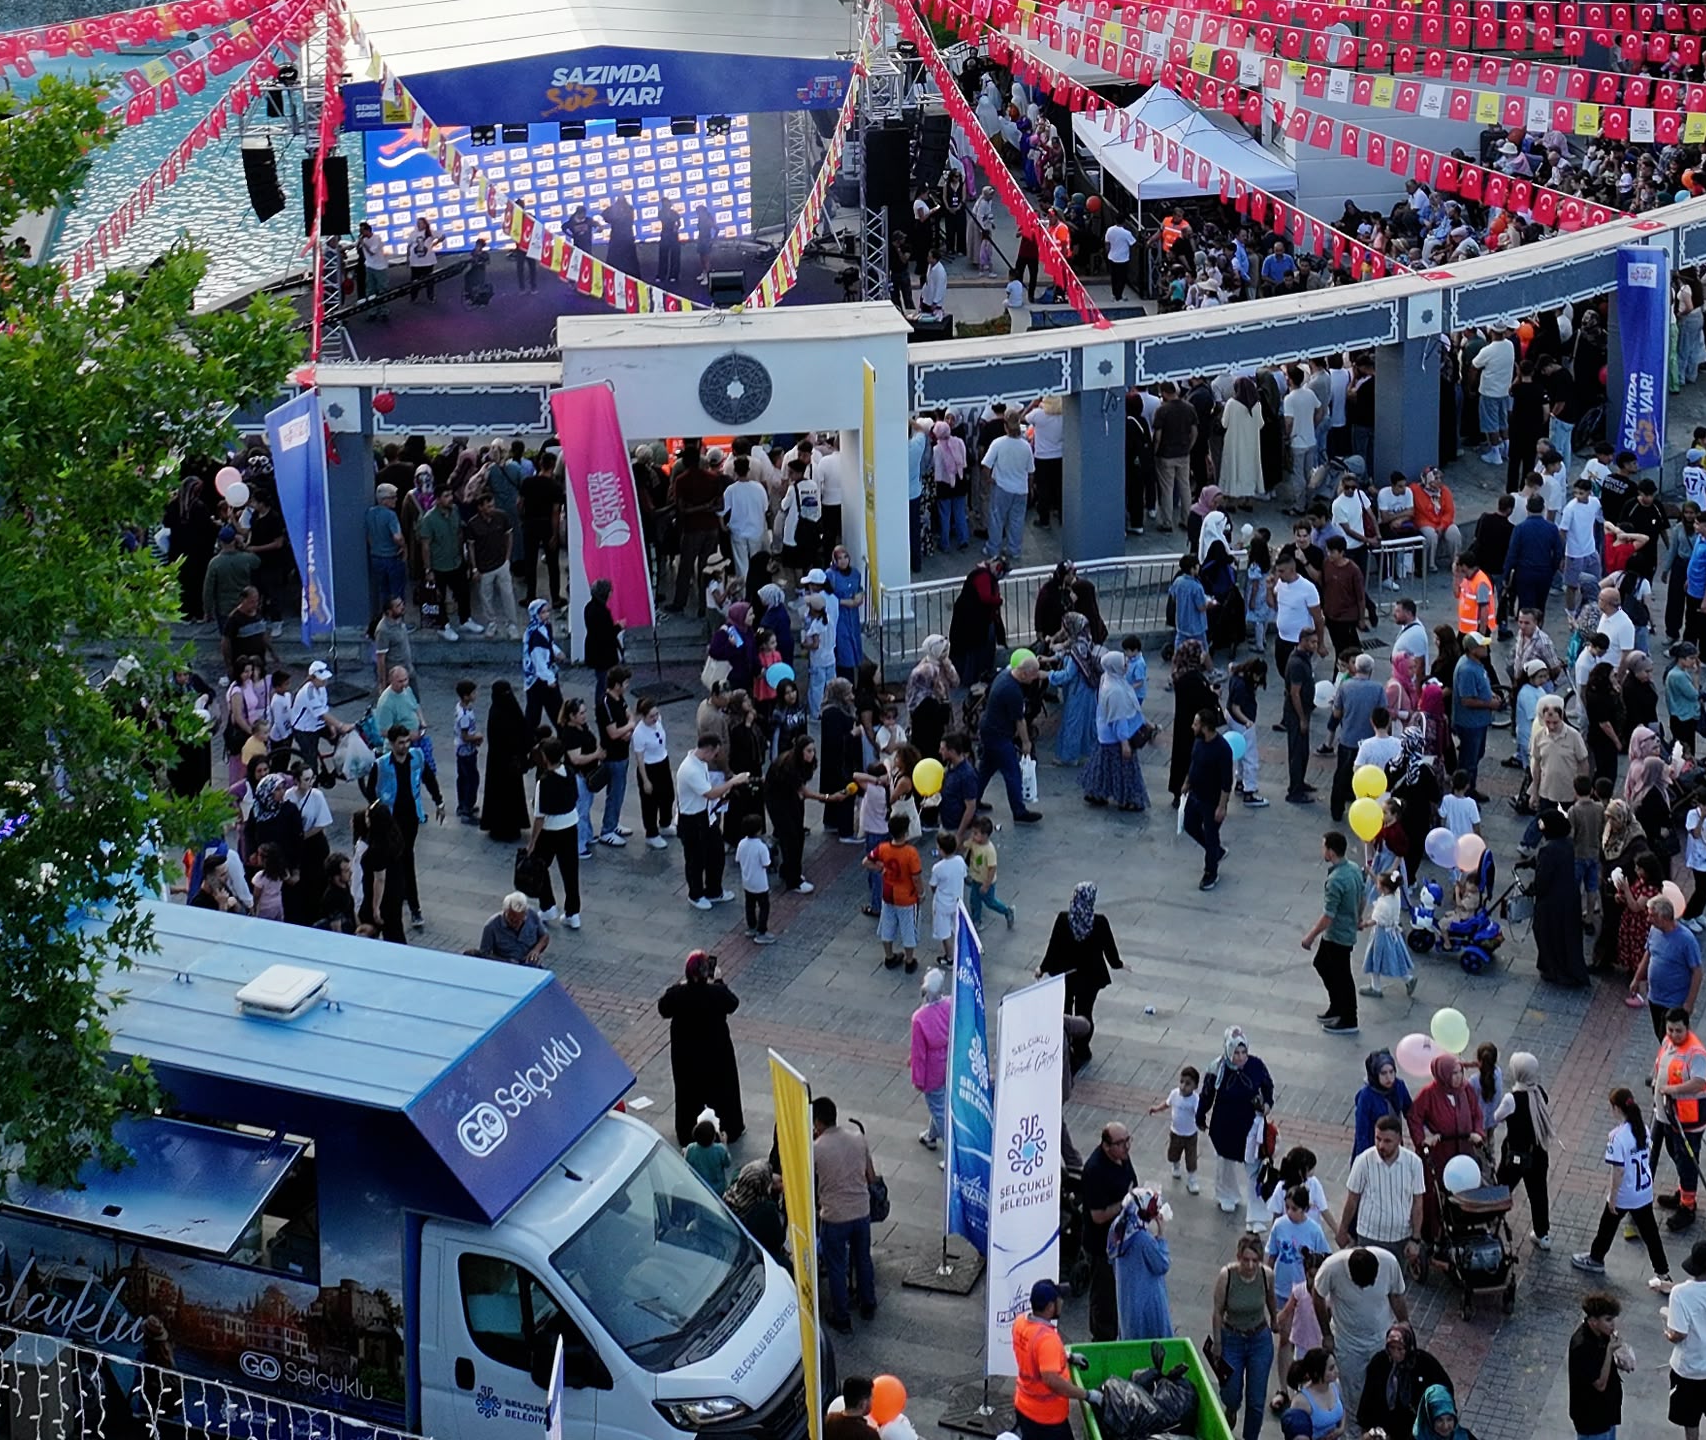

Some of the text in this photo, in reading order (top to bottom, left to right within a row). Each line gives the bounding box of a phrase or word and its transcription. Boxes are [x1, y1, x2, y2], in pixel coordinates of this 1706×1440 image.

[550, 63, 661, 87] SAZIMDA
[606, 87, 665, 108] VAR!
[1623, 372, 1638, 451] SAZIMDA
[1639, 371, 1654, 414] VAR!
[462, 1033, 582, 1152] GO Selçuklu
[999, 1188, 1054, 1214] BELEDİYESİ
[1000, 1174, 1054, 1200] SELÇUKLU
[284, 1361, 374, 1401] Selçuklu
[730, 1339, 767, 1385] SELÇUKLU
